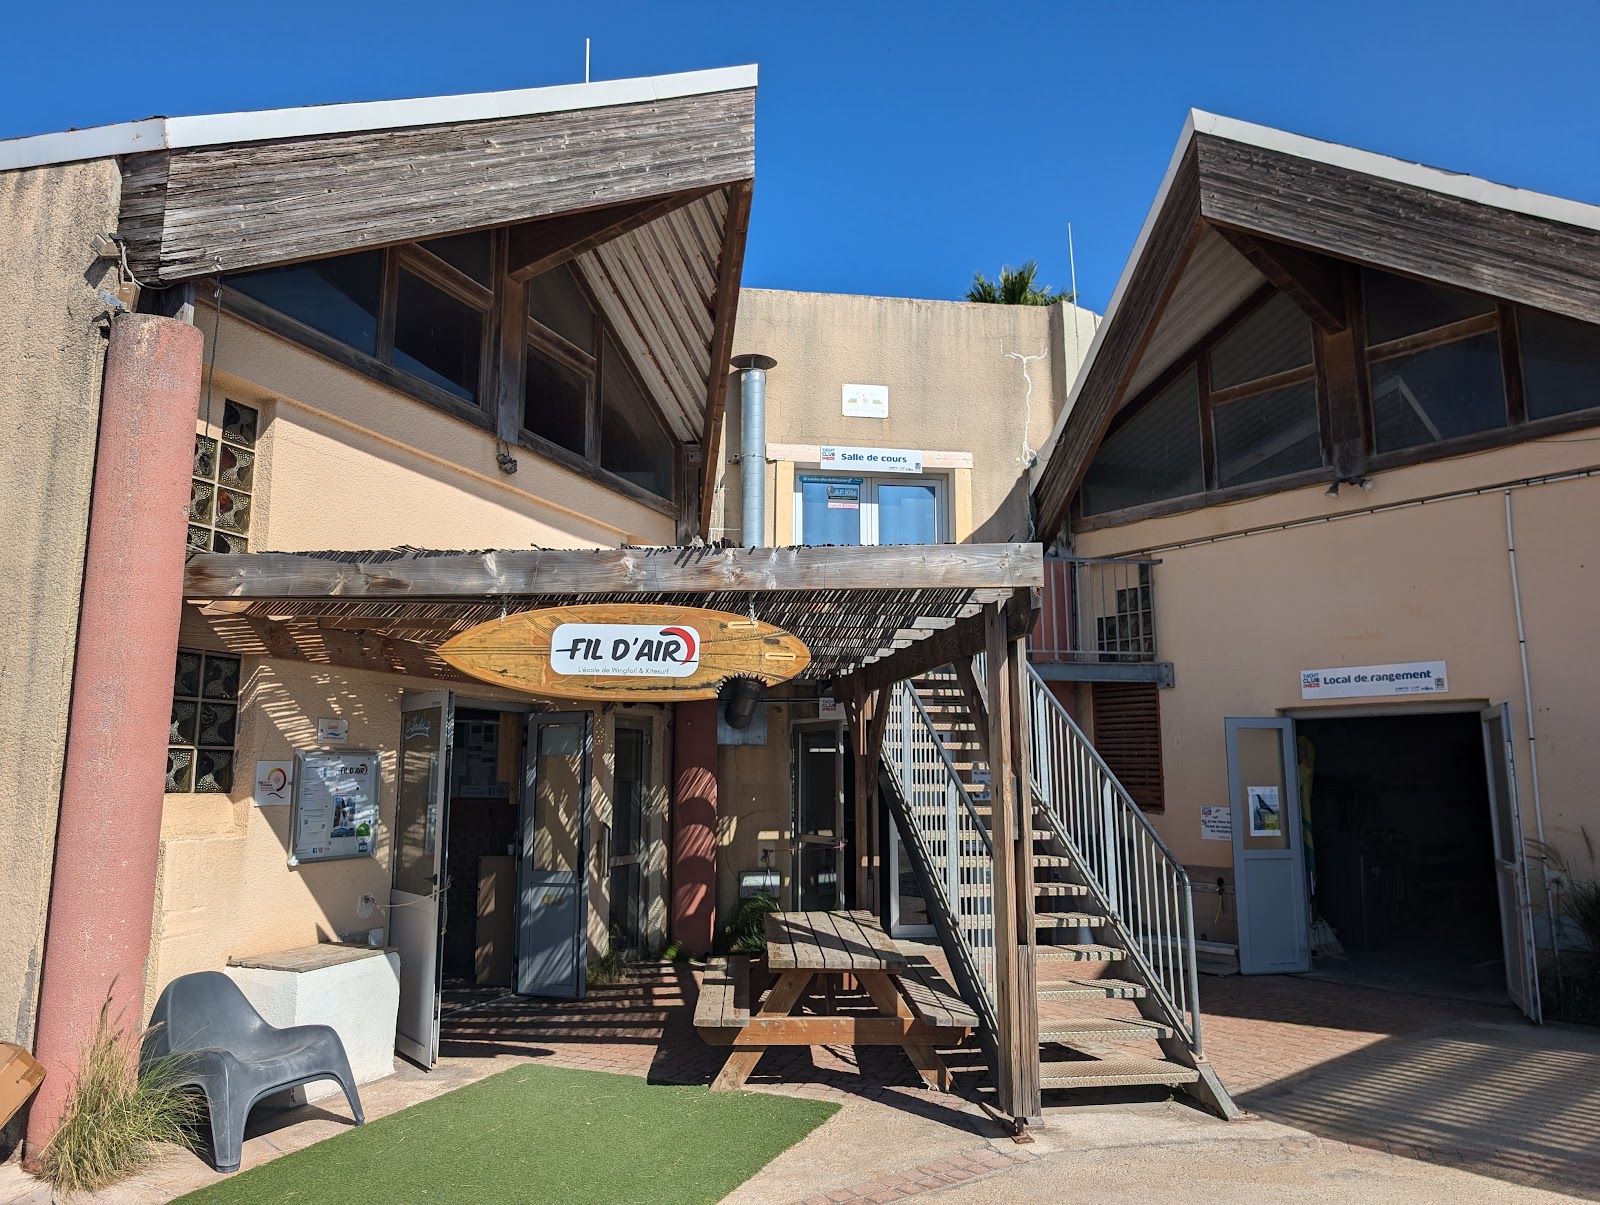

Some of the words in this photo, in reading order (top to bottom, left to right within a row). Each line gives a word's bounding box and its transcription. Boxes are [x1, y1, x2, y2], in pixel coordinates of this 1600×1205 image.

[841, 453, 864, 461] Salle
[867, 454, 879, 462] de
[568, 638, 603, 661] FIL
[611, 637, 682, 663] D'AIR
[611, 666, 638, 676] Wingfoil
[1323, 675, 1351, 685] Local
[1354, 674, 1367, 683] de
[1370, 670, 1431, 682] rangement
